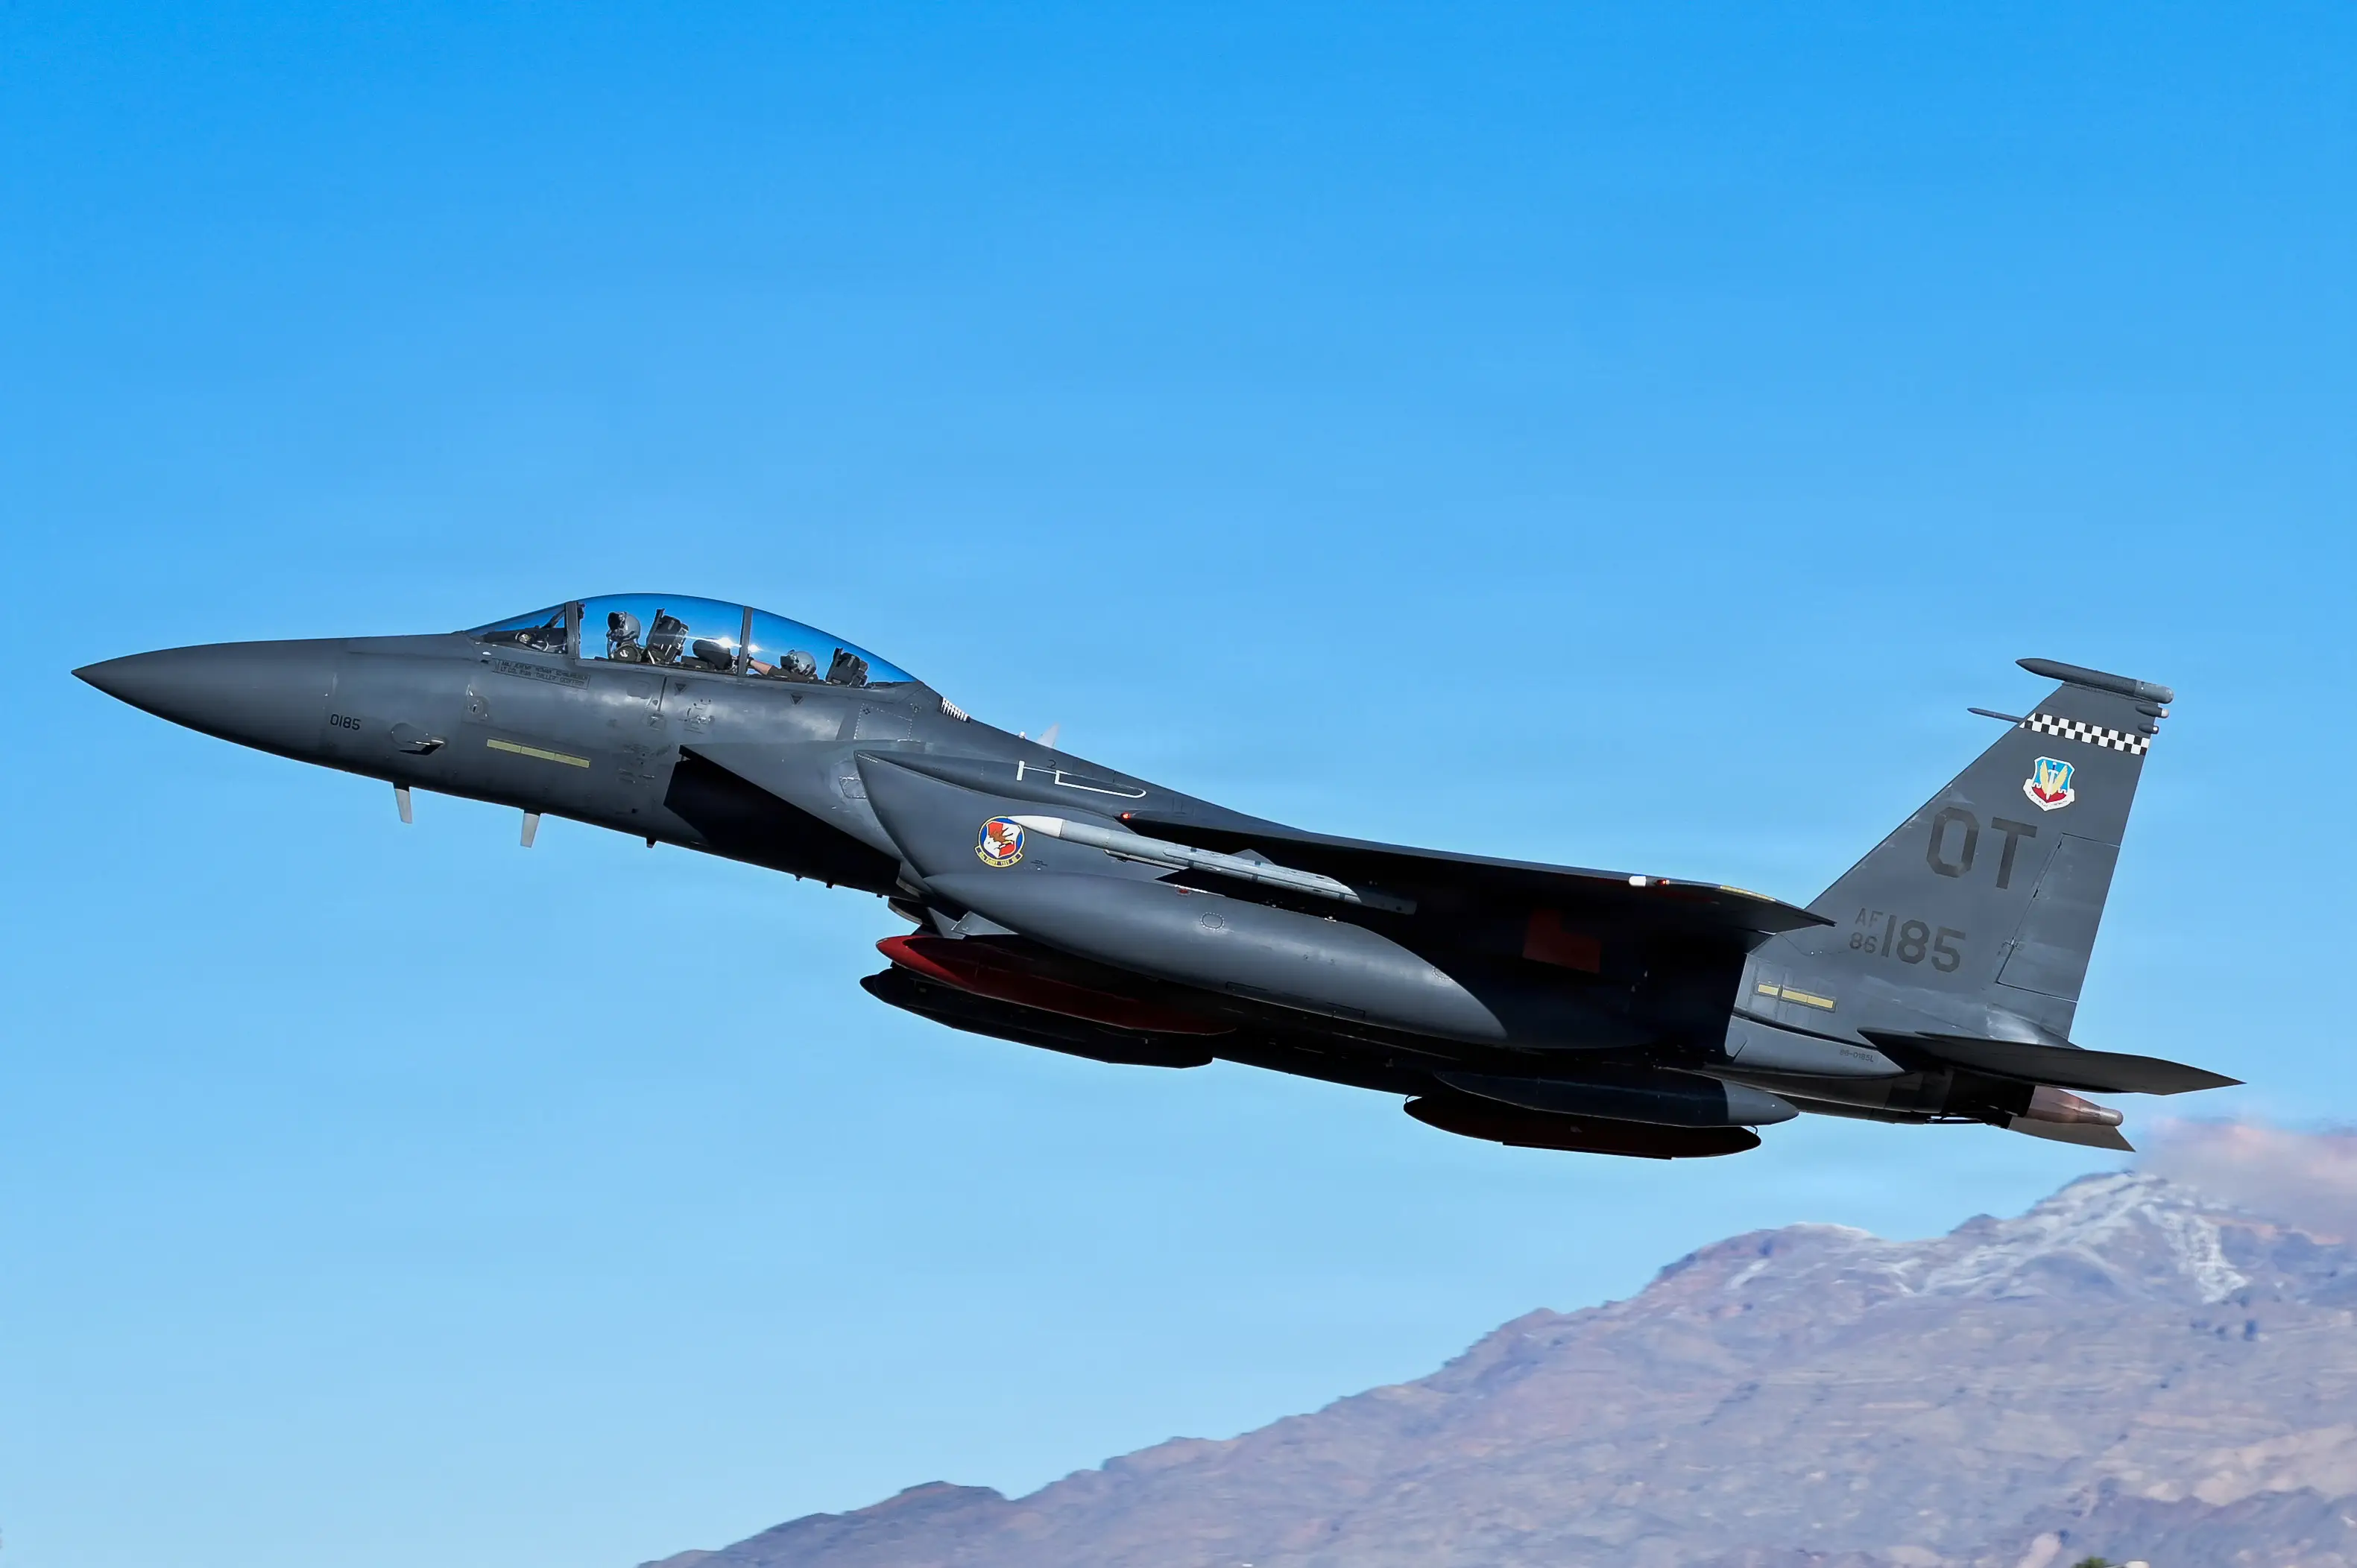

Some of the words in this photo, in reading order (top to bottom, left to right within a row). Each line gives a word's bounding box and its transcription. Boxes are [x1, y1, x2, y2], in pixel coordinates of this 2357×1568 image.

[330, 713, 362, 730] 0185
[1047, 759, 1056, 769] 2
[1926, 806, 2038, 890] OT
[1855, 908, 1884, 928] AF
[1849, 932, 1878, 954] 86
[1881, 914, 1966, 973] 185
